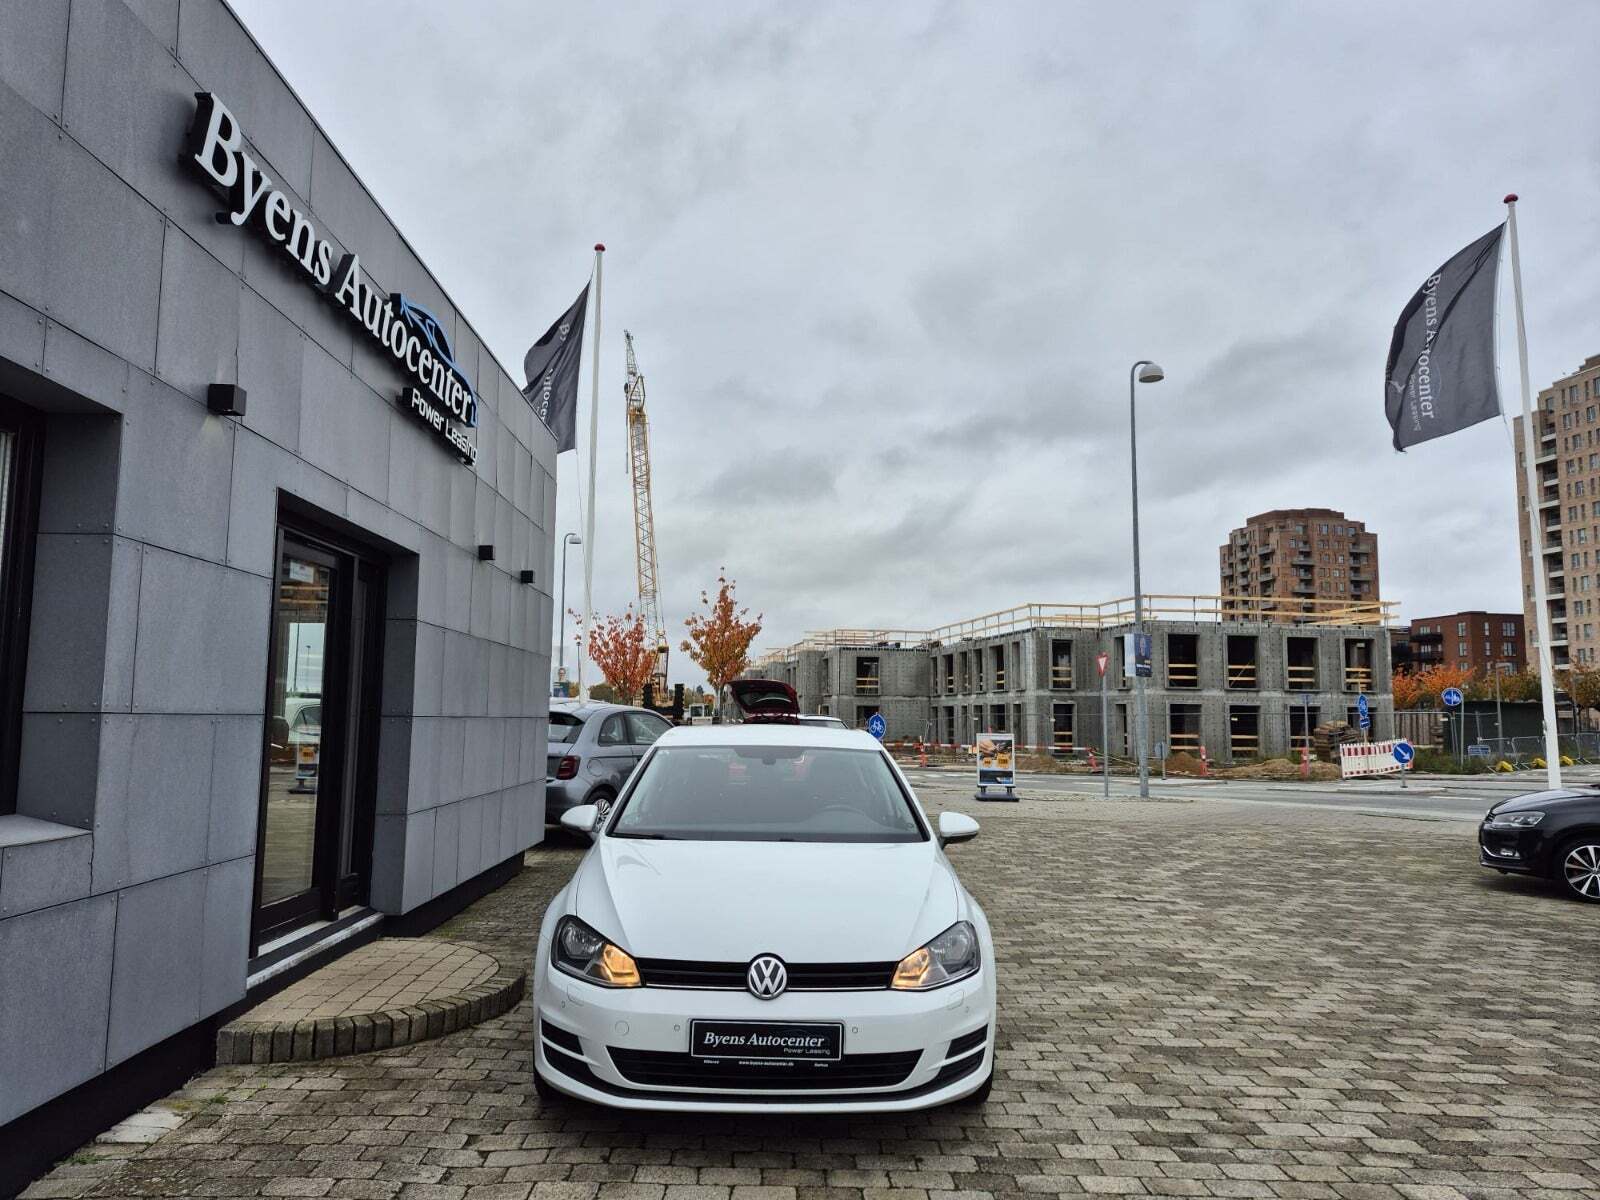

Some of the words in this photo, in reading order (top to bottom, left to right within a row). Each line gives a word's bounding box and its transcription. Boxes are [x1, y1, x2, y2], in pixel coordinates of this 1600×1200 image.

[194, 92, 334, 286] Byens
[335, 254, 472, 422] Autocenter
[1423, 273, 1441, 327] Byens
[1418, 330, 1438, 419] Atocenter
[411, 388, 444, 431] Power
[445, 419, 477, 465] Leasing
[704, 1032, 745, 1047] Byens
[748, 1033, 824, 1047] Autocenter
